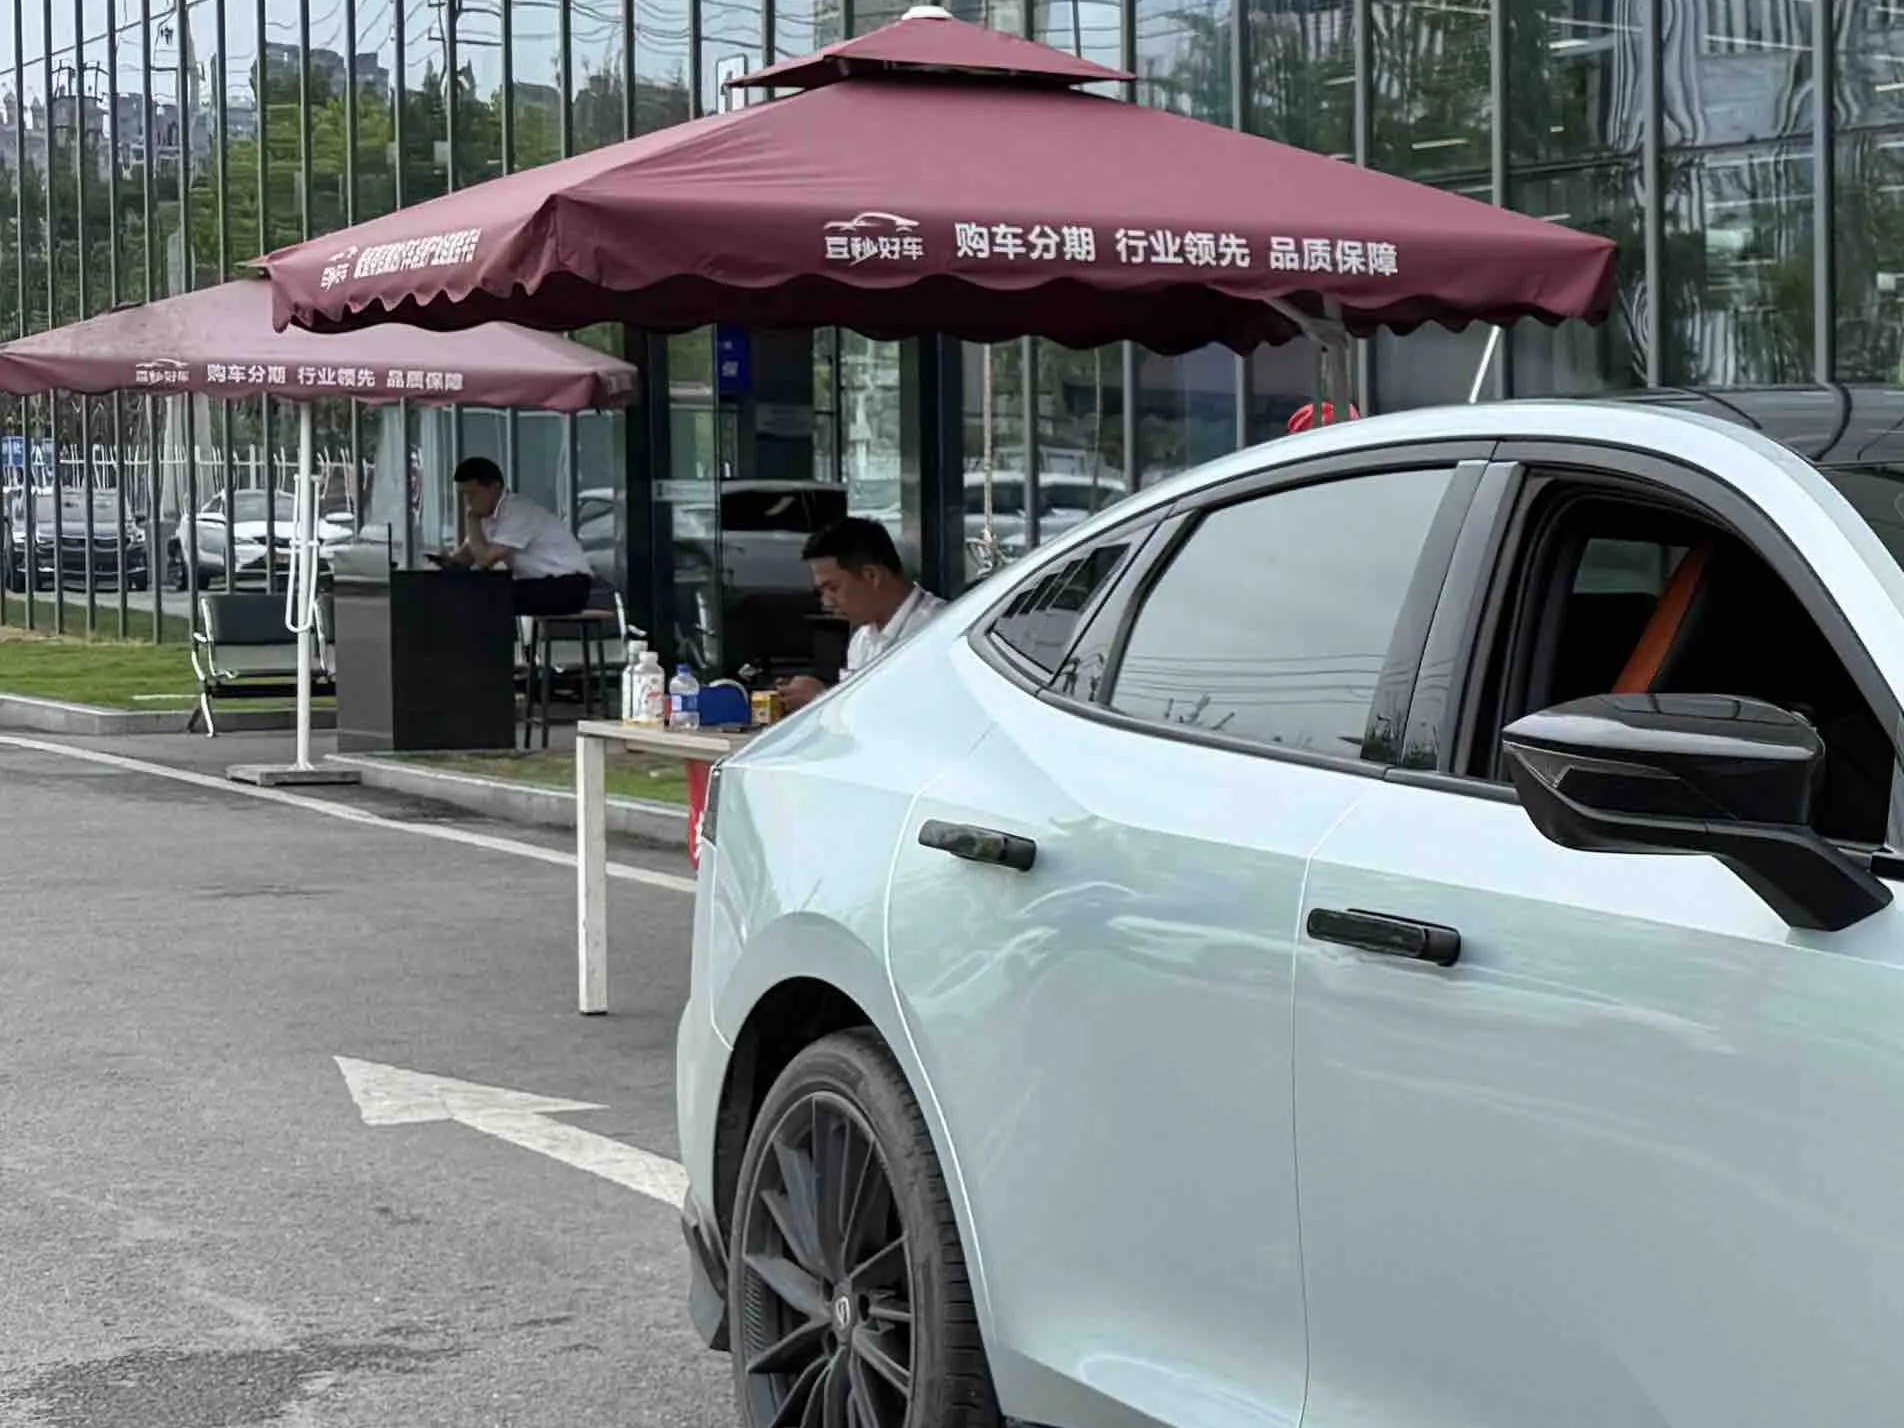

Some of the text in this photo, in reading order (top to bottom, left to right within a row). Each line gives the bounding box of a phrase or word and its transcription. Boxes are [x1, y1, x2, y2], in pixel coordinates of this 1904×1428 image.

[954, 223, 1096, 262] 购车分期
[1115, 227, 1250, 268] 行业领先
[1269, 235, 1399, 276] 品质保障
[207, 364, 286, 384] 购车分期
[298, 366, 376, 387] 行业领先
